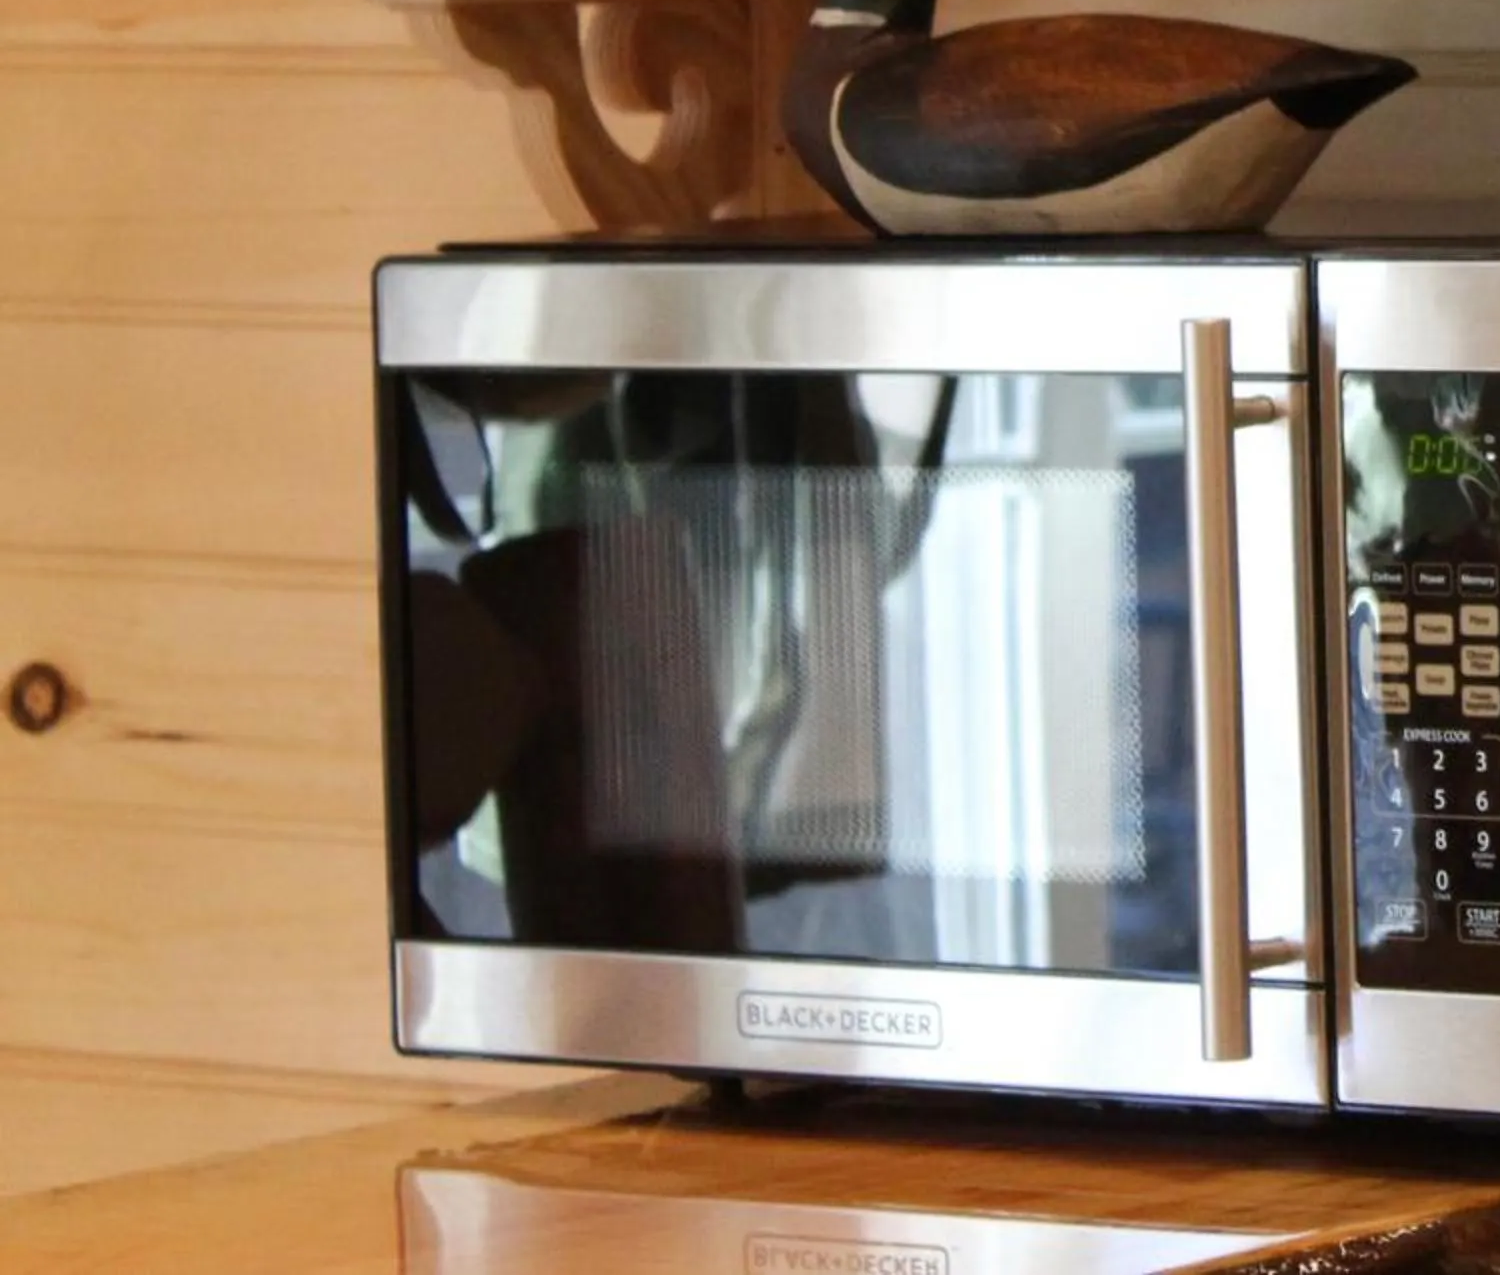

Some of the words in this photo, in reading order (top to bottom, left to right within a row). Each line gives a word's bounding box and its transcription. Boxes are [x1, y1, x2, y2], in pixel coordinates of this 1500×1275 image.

[1403, 728, 1441, 743] EXPRESS
[1443, 730, 1472, 744] COOK
[1390, 747, 1401, 769] 1
[1432, 749, 1446, 771] 2
[1474, 750, 1488, 773] 3
[1388, 787, 1403, 808] 4
[1433, 789, 1446, 811] 5
[1474, 789, 1489, 813] 6
[1390, 827, 1404, 848] 7
[1434, 828, 1448, 850] 8
[1476, 830, 1491, 852] 9
[1435, 870, 1450, 891] 0
[1385, 902, 1417, 920] STOP
[1466, 906, 1500, 923] START
[745, 1003, 933, 1035] BLACK+DECKER
